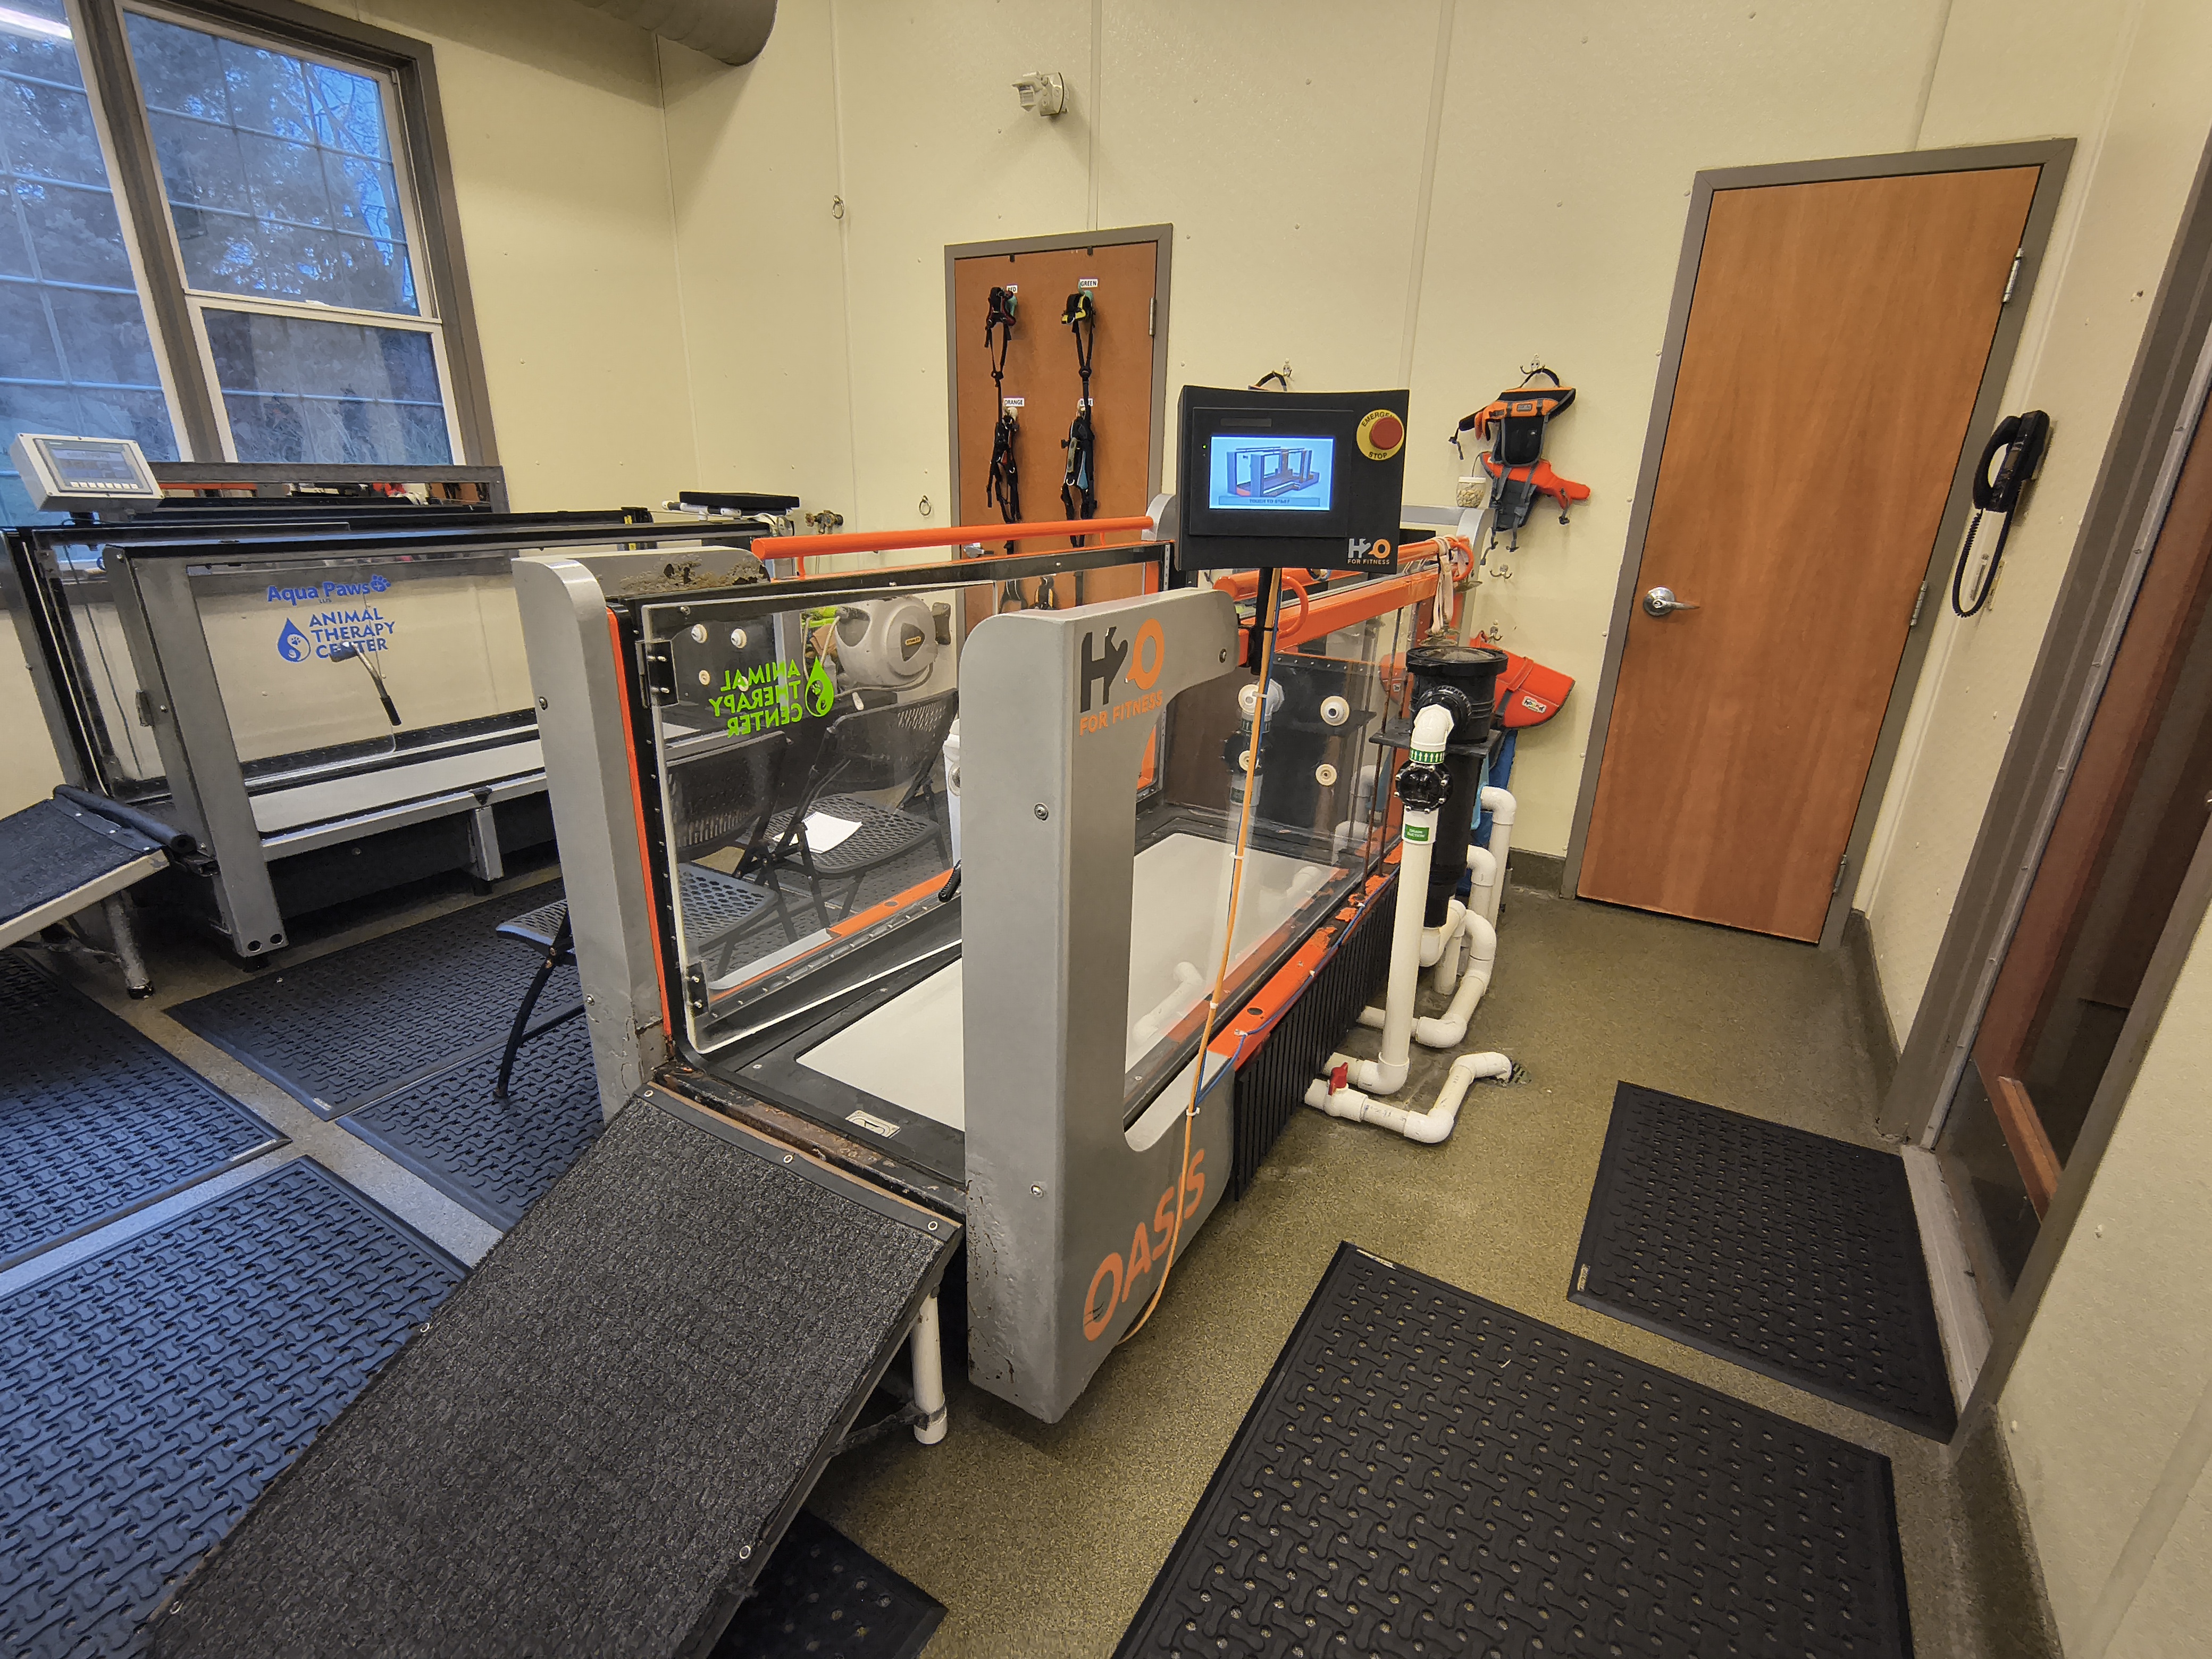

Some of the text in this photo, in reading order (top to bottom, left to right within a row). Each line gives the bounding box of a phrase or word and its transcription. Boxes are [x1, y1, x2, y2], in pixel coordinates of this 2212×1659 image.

[1362, 412, 1394, 427] EMERGE
[267, 581, 370, 606] Aqua Paws
[309, 608, 383, 627] ANIMAL
[311, 621, 395, 642] THERAPY
[1079, 689, 1163, 737] FOR FITNESS
